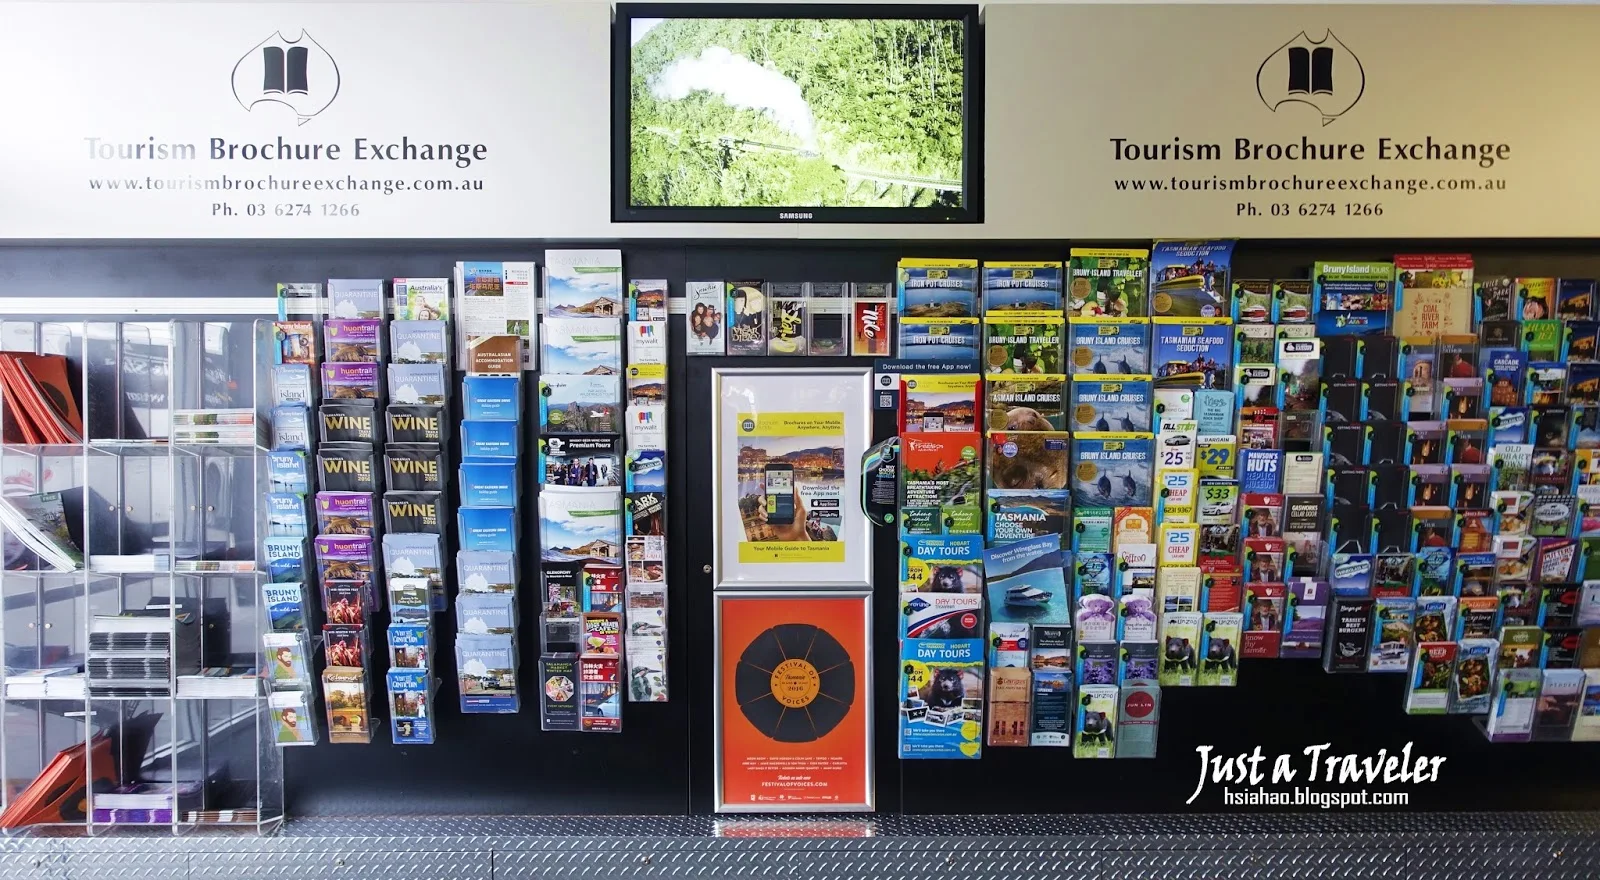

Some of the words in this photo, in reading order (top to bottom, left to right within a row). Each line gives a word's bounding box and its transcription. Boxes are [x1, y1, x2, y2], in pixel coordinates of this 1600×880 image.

[84, 137, 197, 161] Tourism
[209, 137, 341, 161] Brochure
[354, 137, 488, 168] Exchange
[1109, 137, 1221, 160] Tourism
[1234, 137, 1365, 160] Brochure
[1378, 137, 1511, 168] Exchange
[89, 173, 484, 195] www.tourismbrochureexchange.com.au
[1114, 175, 1507, 194] www.tourismbrochureexchange.com.au
[212, 203, 238, 216] Ph.
[246, 203, 266, 216] 03
[274, 203, 312, 217] 6274
[321, 203, 360, 217] 1266
[1236, 203, 1262, 216] Ph.
[1271, 203, 1290, 216] 03
[1298, 203, 1336, 216] 6274
[1345, 203, 1384, 216] 1266
[779, 212, 813, 220] SAMSUNG
[1072, 269, 1090, 278] BRUNY
[1091, 269, 1111, 278] ISLAND
[1112, 269, 1142, 278] TRAVELLER
[911, 279, 924, 288] IRON
[926, 279, 937, 288] POT
[940, 279, 963, 288] CRUISES
[997, 279, 1010, 288] IRON
[1011, 279, 1023, 288] POT
[1025, 279, 1049, 288] CRUISES
[1422, 304, 1438, 313] COAL
[1421, 312, 1440, 321] RIVER
[1421, 321, 1439, 329] FARM
[988, 336, 1007, 344] BRUNY
[1007, 336, 1027, 344] ISLAND
[1029, 336, 1059, 344] TRAVELLER
[1076, 337, 1094, 345] BRUNY
[1095, 337, 1116, 345] ISLAND
[1117, 337, 1141, 345] CRUISES
[1161, 337, 1196, 345] TASMANIAN
[1197, 337, 1224, 345] SEAFOOD
[1176, 344, 1210, 353] SEDUCTION
[882, 363, 914, 371] Download
[927, 363, 940, 371] free
[941, 364, 955, 373] App
[394, 375, 439, 383] QUARANTINE
[1014, 394, 1035, 402] ISLAND
[1036, 394, 1061, 402] CRUISES
[1078, 394, 1097, 402] BRUNY
[1098, 394, 1119, 402] ISLAND
[1120, 394, 1144, 402] CRUISES
[325, 416, 371, 430] WINE
[391, 417, 439, 430] WINE
[1080, 451, 1099, 460] BRUNY
[1100, 451, 1121, 460] ISLAND
[1122, 451, 1146, 460] CRUISES
[1247, 452, 1279, 460] MAWSON'S
[323, 460, 370, 474] WINE
[390, 460, 438, 474] WINE
[1247, 459, 1278, 472] HUTS
[813, 490, 825, 498] App
[1206, 488, 1231, 500] $33
[389, 504, 435, 518] WINE
[994, 513, 1047, 522] TASMANIA
[267, 544, 299, 552] BRUNY
[917, 546, 937, 556] DAY
[938, 546, 971, 556] TOURS
[990, 549, 1013, 560] Discover
[1042, 541, 1053, 550] Bay
[1168, 545, 1190, 554] CHEAP
[268, 551, 300, 559] ISLAND
[1002, 555, 1016, 564] from
[463, 564, 509, 572] QUARANTINE
[266, 589, 297, 597] BRUNY
[267, 595, 299, 603] ISLAND
[462, 608, 508, 617] QUARANTINE
[461, 650, 508, 658] QUARANTINE
[917, 649, 937, 658] DAY
[939, 649, 971, 658] TOURS
[774, 661, 807, 680] FESTIVAL
[808, 670, 818, 680] OF
[782, 695, 811, 706] VOICES
